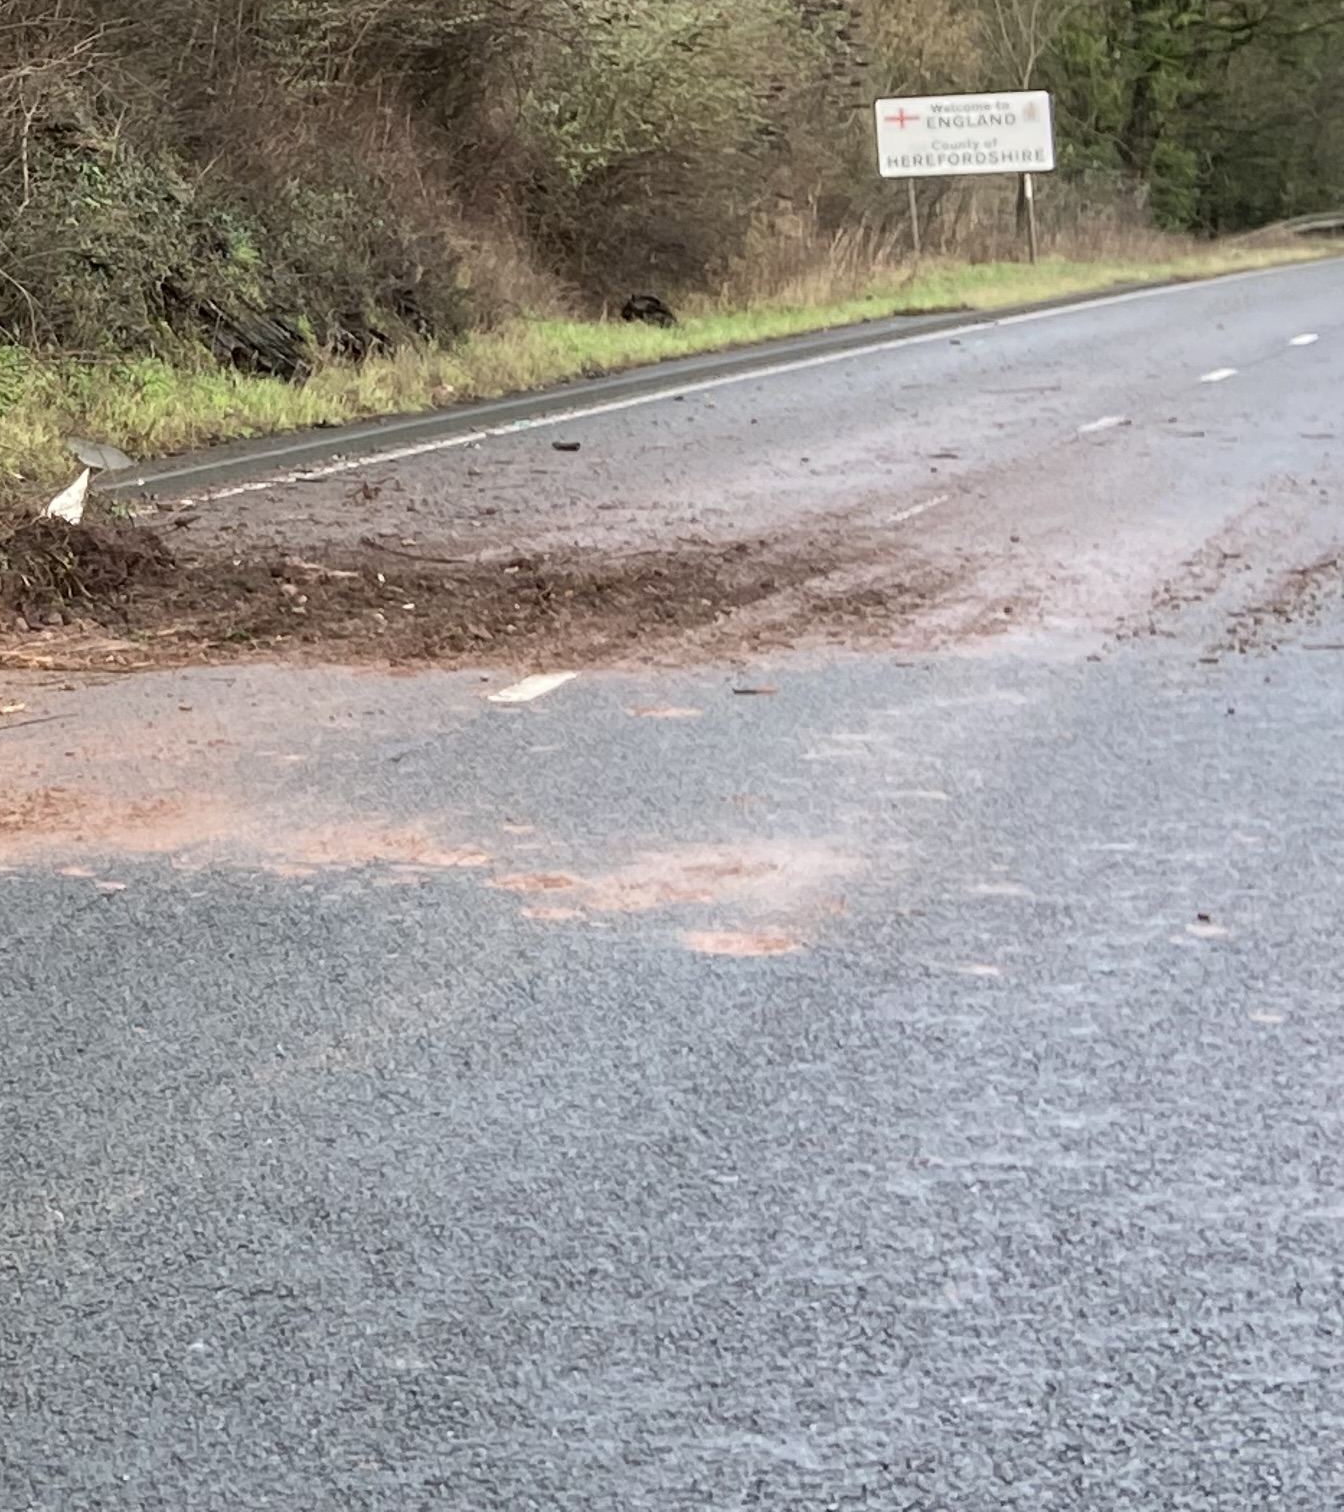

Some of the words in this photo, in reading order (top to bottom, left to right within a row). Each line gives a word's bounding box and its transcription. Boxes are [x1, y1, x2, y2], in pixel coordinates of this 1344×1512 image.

[930, 101, 991, 113] Welcome
[996, 100, 1010, 111] to
[926, 113, 1016, 129] ENGLAND
[931, 138, 980, 151] County
[984, 137, 998, 149] of
[886, 149, 1046, 169] HEREFORDSHIRE
